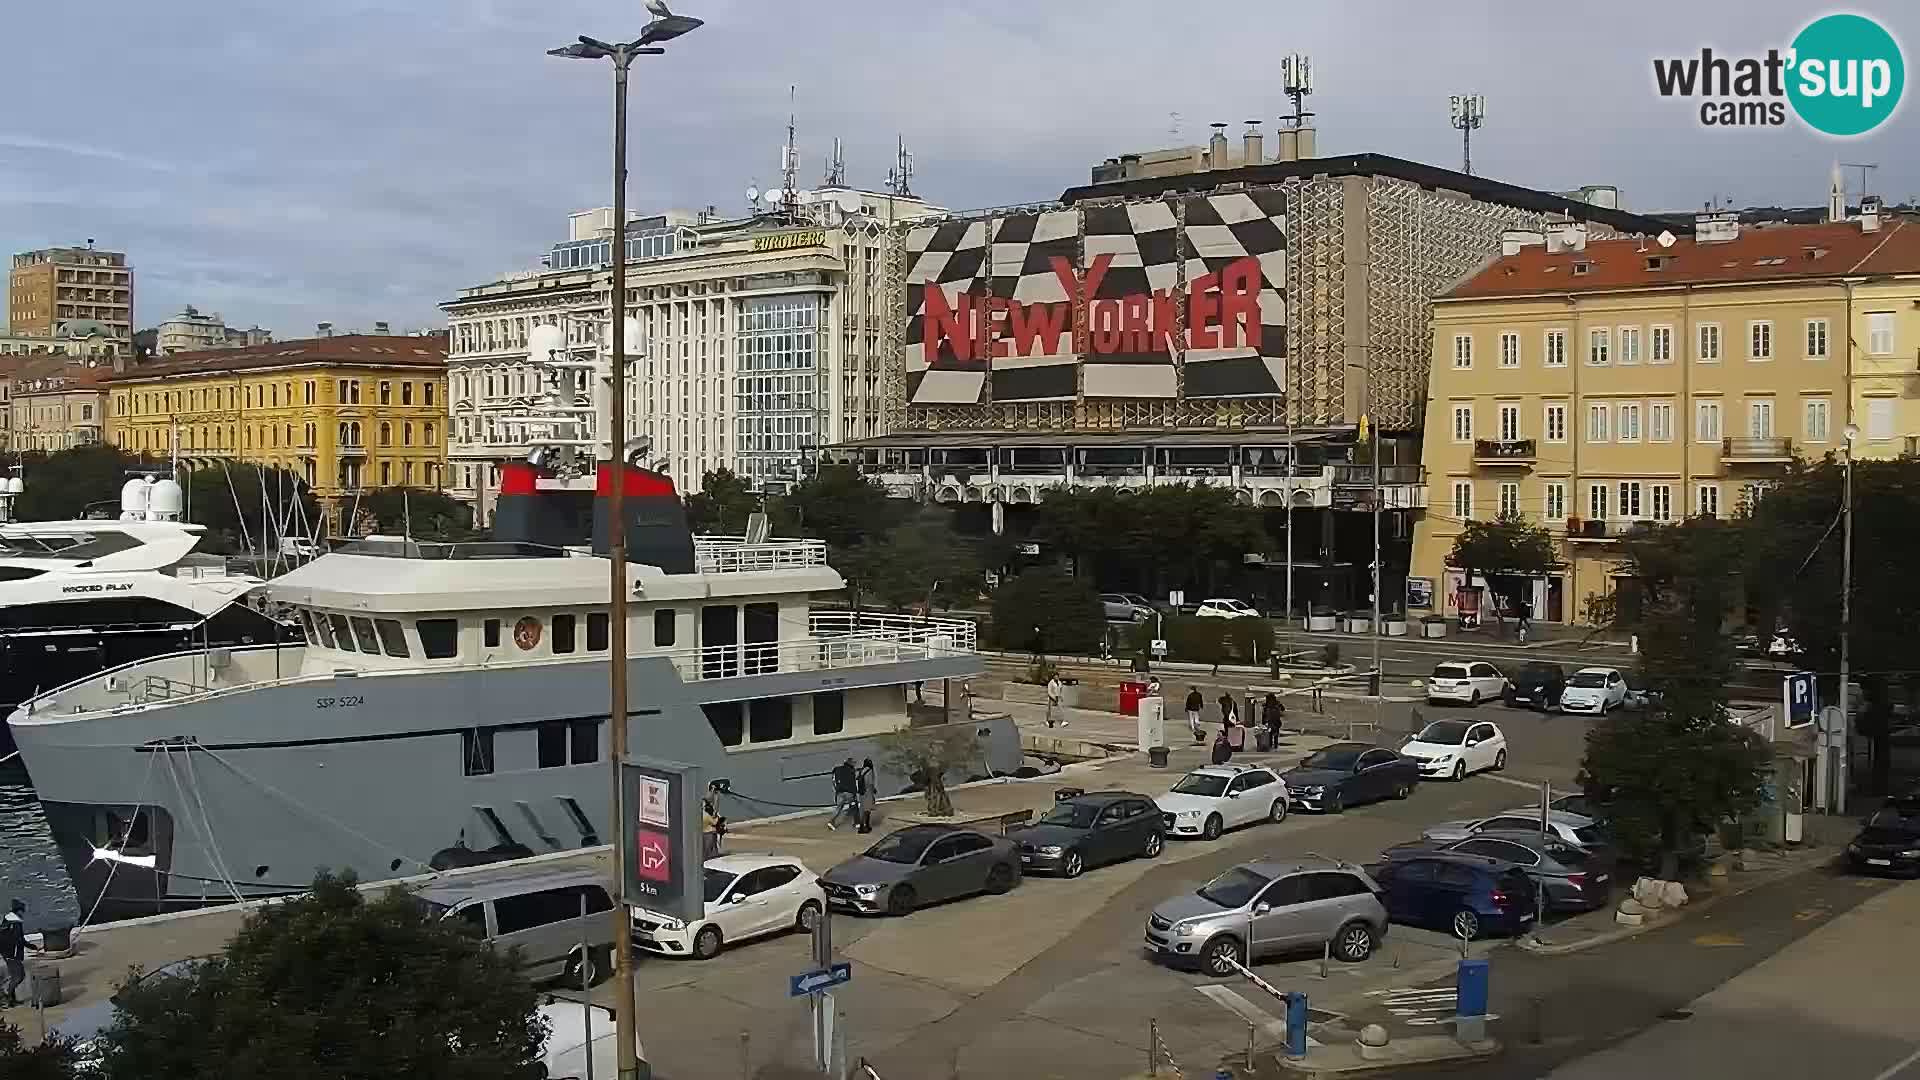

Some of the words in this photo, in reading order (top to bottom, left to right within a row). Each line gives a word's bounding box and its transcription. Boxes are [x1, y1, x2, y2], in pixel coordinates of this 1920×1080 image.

[62, 584, 103, 593] WICKED
[105, 583, 133, 591] PLAY
[339, 696, 364, 707] 5224
